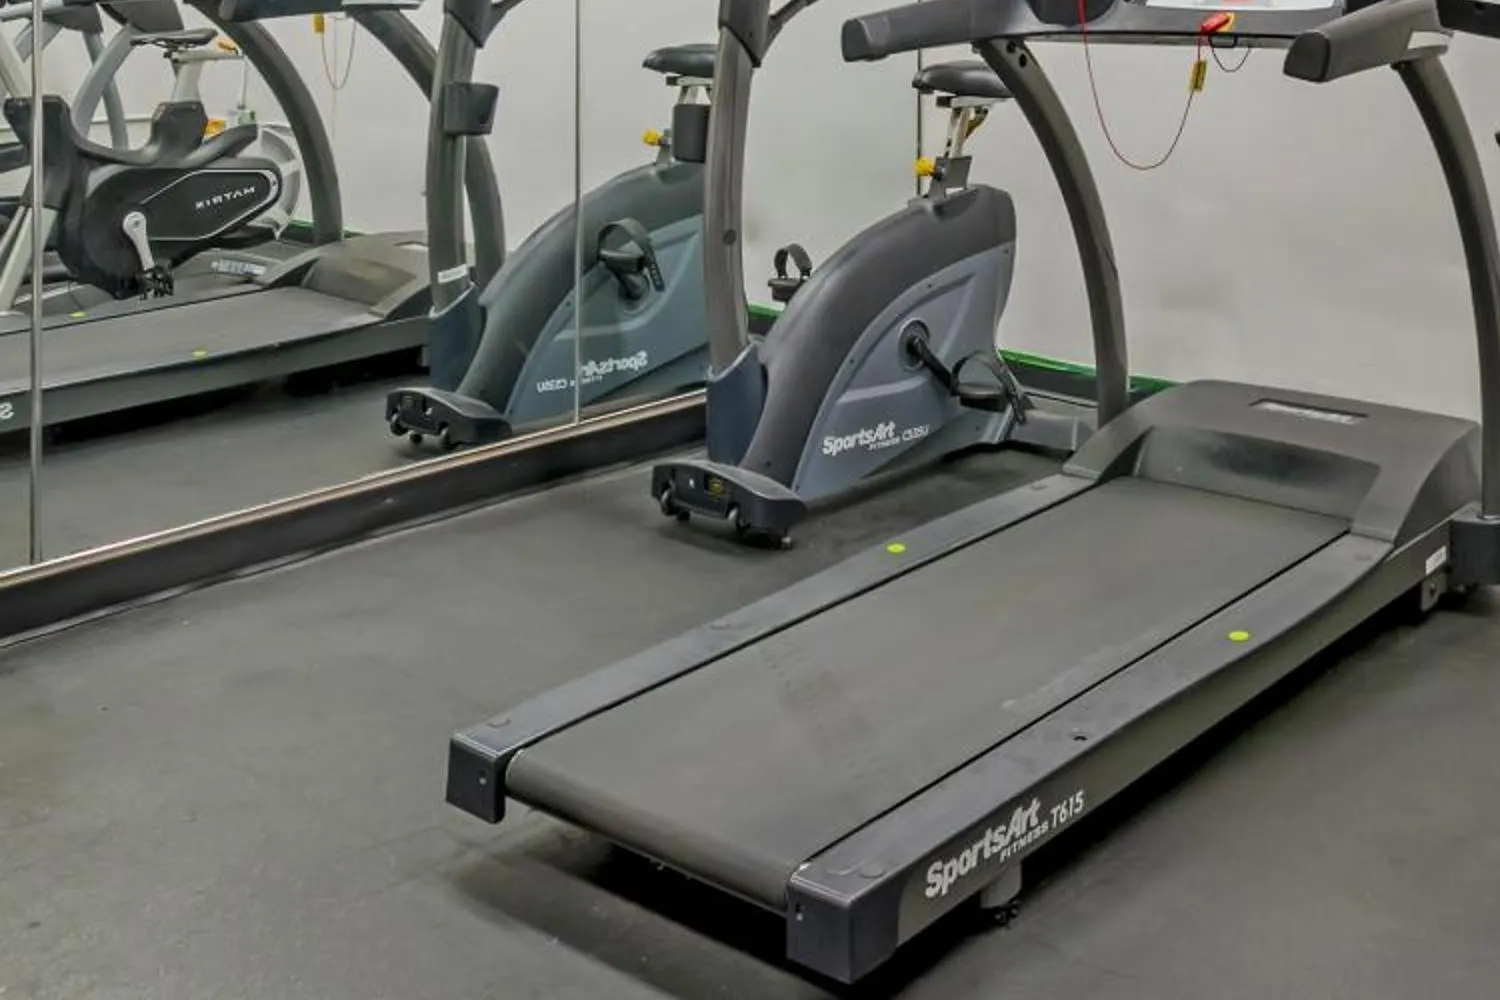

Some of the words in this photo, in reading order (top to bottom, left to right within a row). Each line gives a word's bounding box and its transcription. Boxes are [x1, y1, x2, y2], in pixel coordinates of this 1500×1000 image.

[822, 421, 896, 457] SportsArt
[925, 797, 1041, 898] SportsArt
[1000, 820, 1049, 862] FITNESS
[1050, 789, 1085, 828] T615
